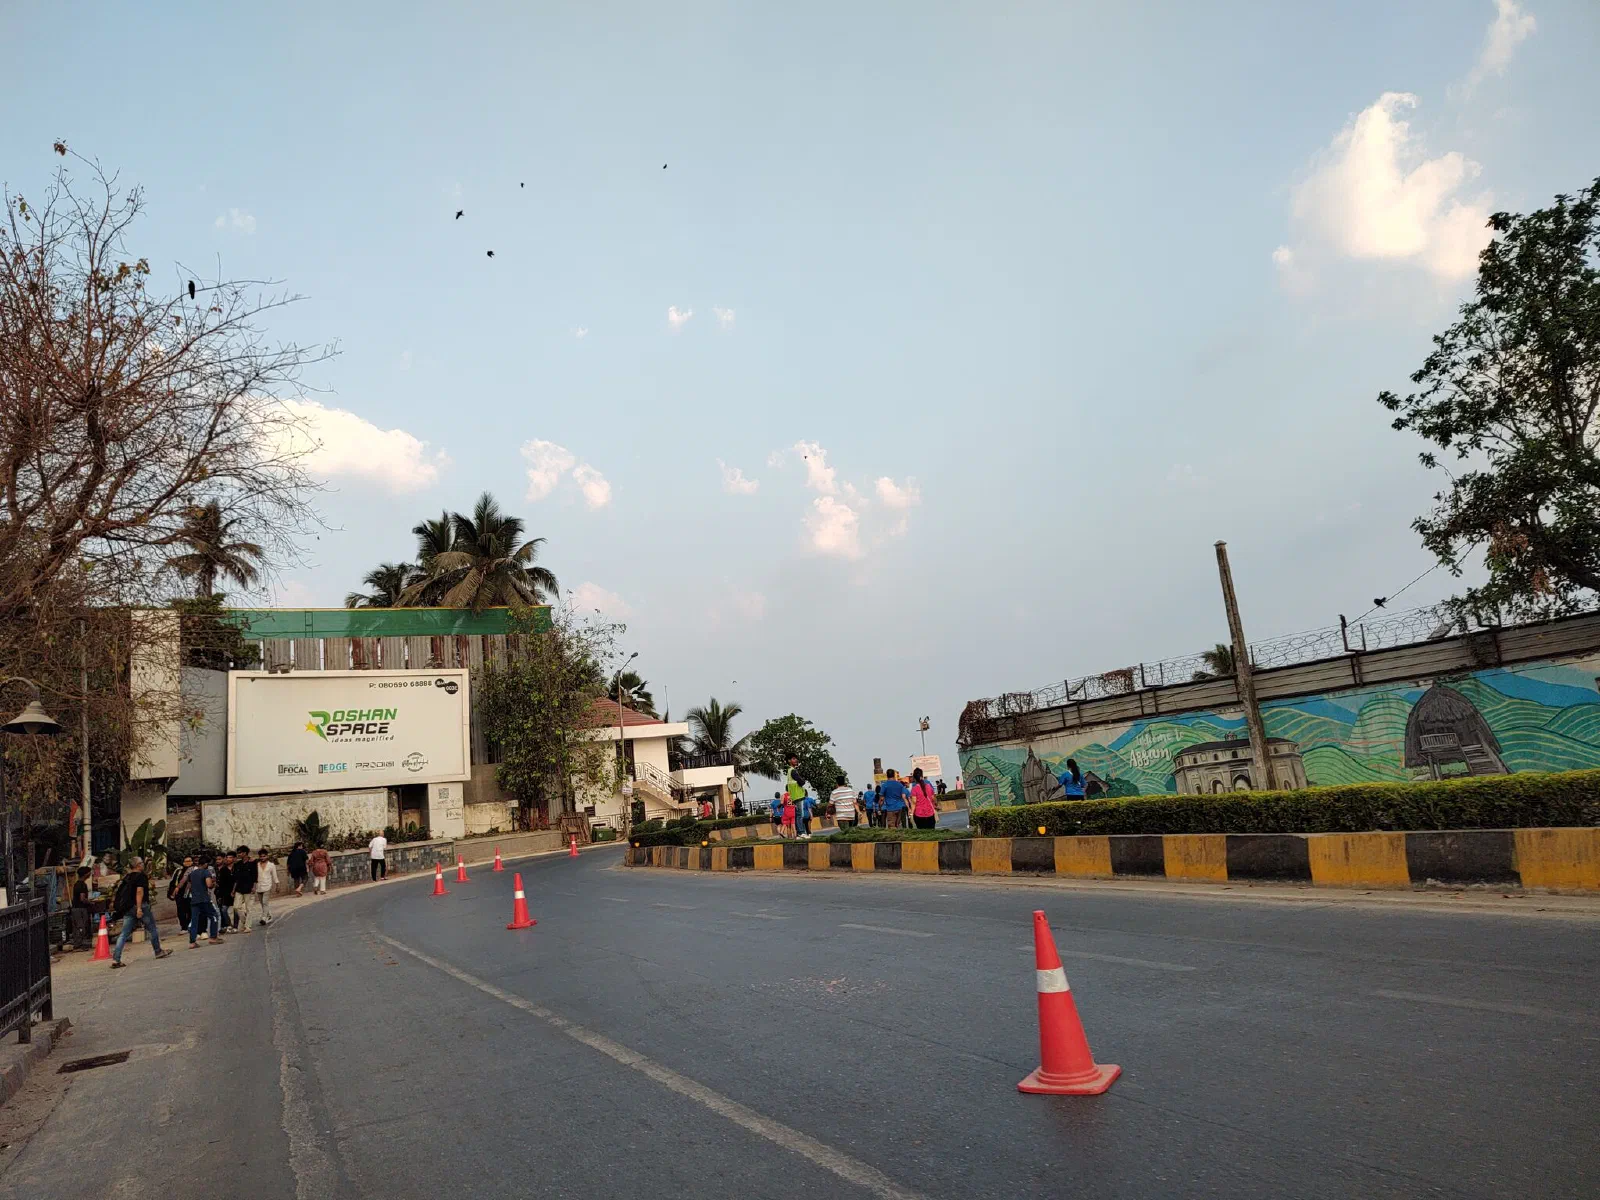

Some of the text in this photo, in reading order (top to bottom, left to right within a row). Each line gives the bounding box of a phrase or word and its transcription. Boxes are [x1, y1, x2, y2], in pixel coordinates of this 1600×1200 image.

[326, 722, 390, 736] SPACE
[283, 766, 309, 774] FOCAL
[323, 762, 348, 771] EDGE
